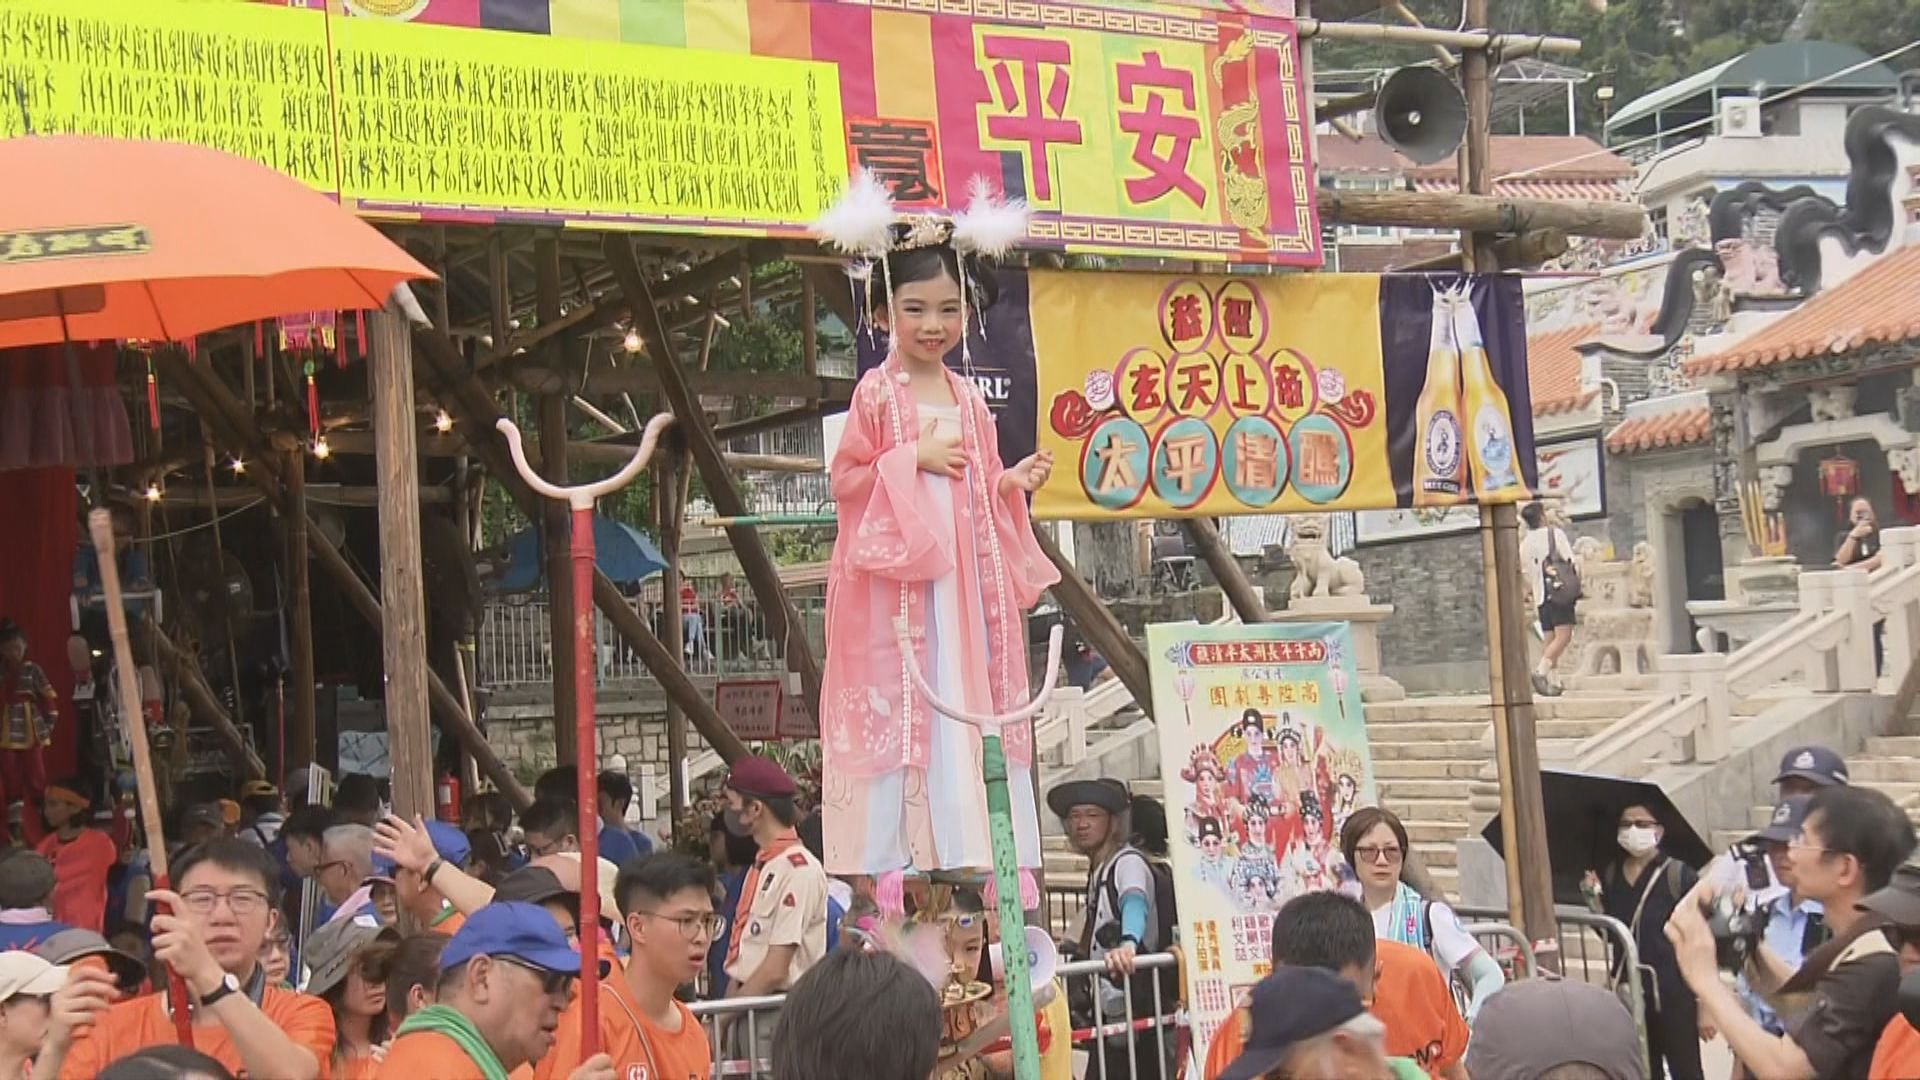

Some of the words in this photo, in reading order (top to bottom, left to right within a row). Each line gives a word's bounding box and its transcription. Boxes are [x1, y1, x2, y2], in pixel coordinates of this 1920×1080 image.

[981, 33, 1207, 210] 平安
[1127, 362, 1305, 412] 玄天上帝
[1093, 429, 1342, 497] 太平清醮
